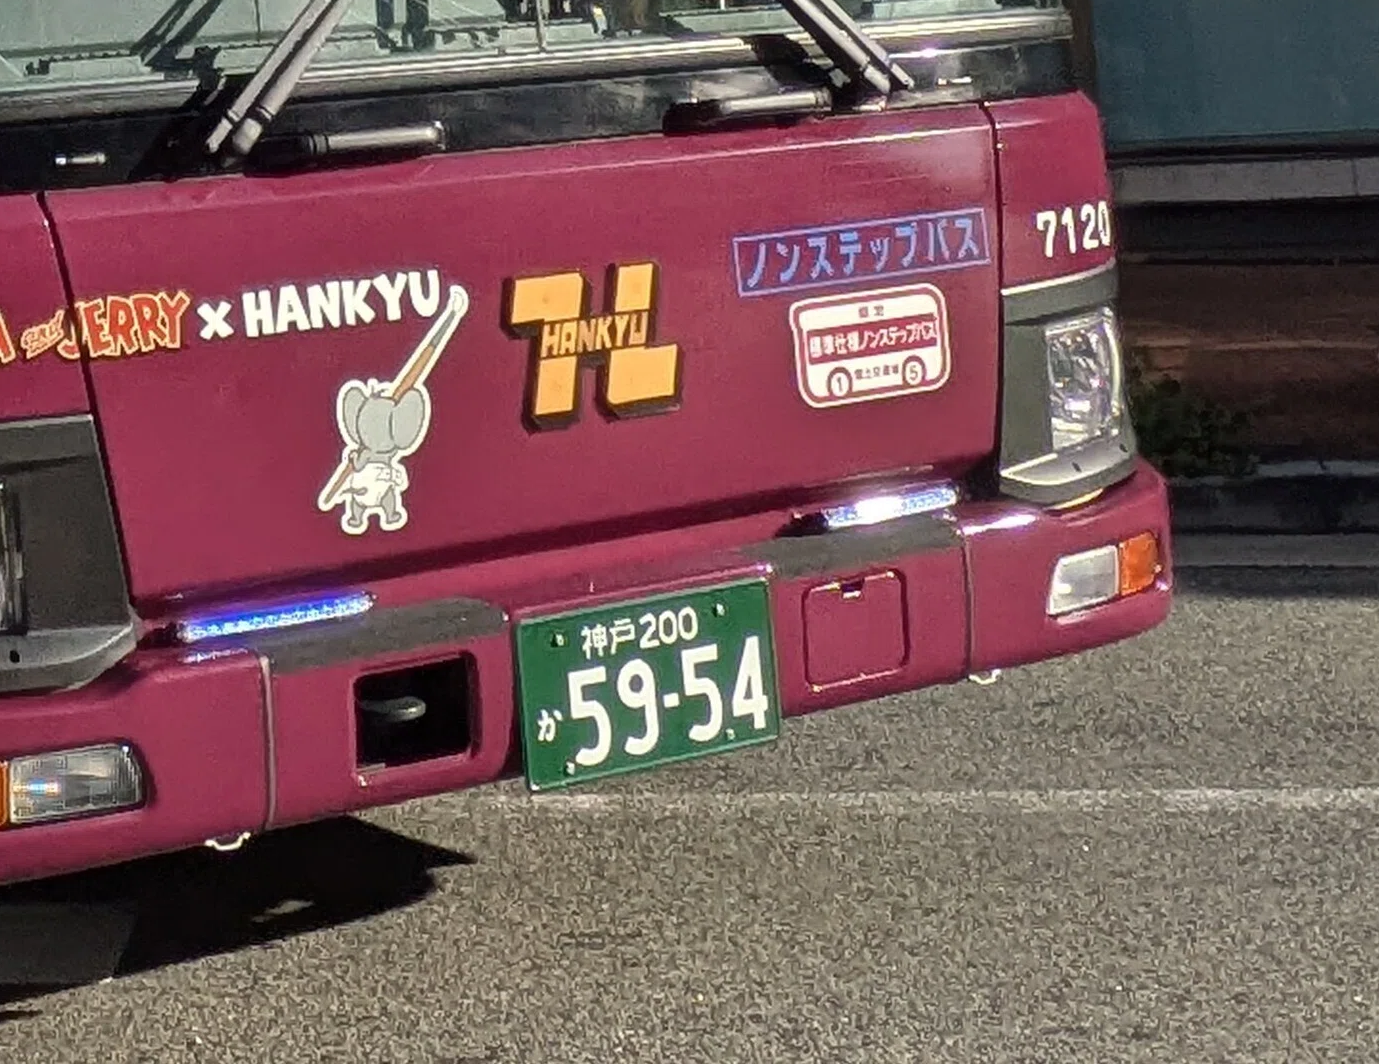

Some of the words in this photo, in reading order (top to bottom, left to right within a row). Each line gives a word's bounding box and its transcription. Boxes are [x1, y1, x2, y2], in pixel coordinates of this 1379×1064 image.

[746, 217, 980, 288] ノンステップバス
[1036, 200, 1112, 258] 7120
[56, 290, 191, 360] JERRY
[242, 269, 440, 338] HANKYU
[540, 311, 650, 359] HANKYU
[537, 708, 564, 743] か
[567, 635, 769, 767] 59-54
